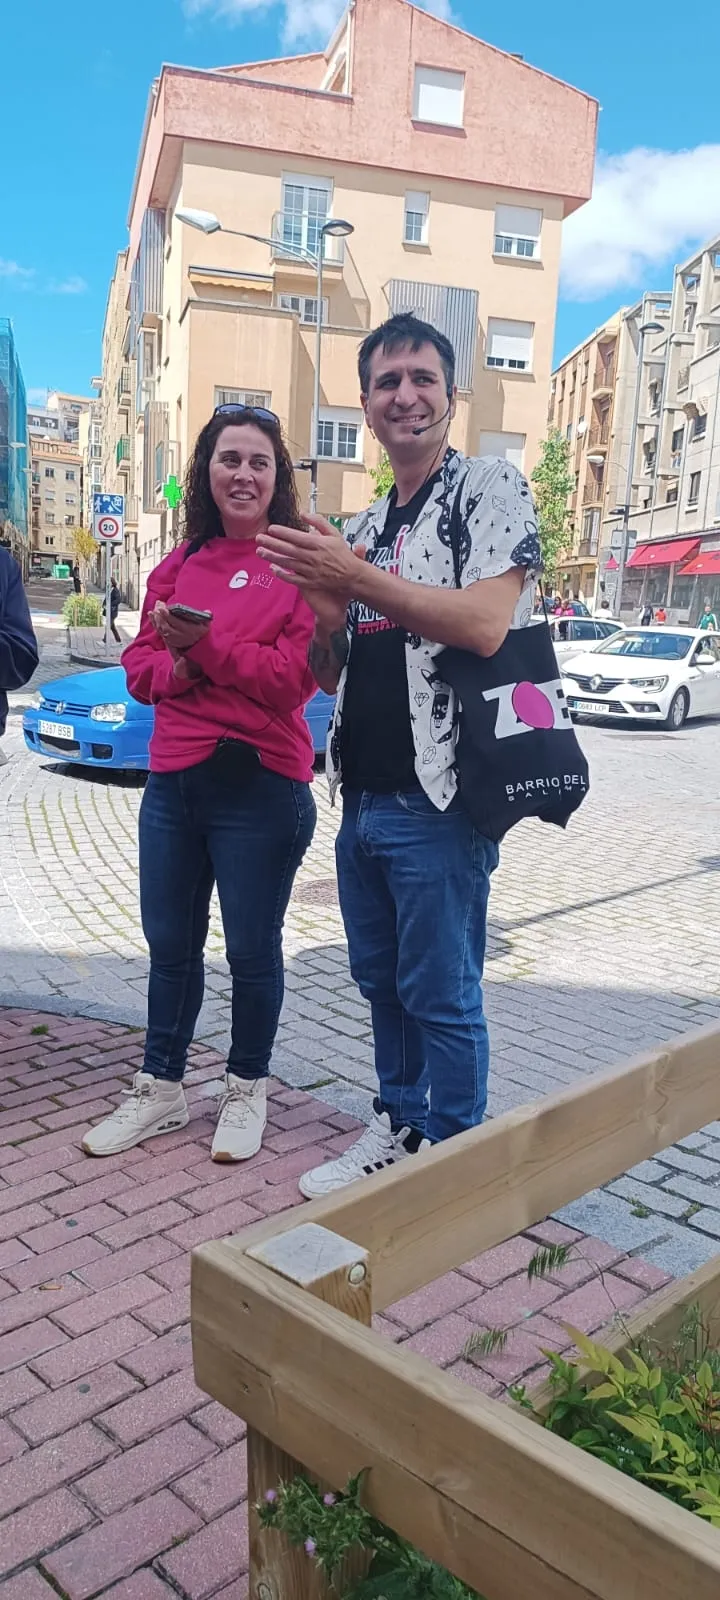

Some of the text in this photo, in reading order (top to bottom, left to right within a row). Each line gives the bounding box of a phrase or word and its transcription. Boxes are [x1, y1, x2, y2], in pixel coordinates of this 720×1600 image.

[103, 523, 114, 531] 20
[505, 774, 587, 795] BARRIO DEL
